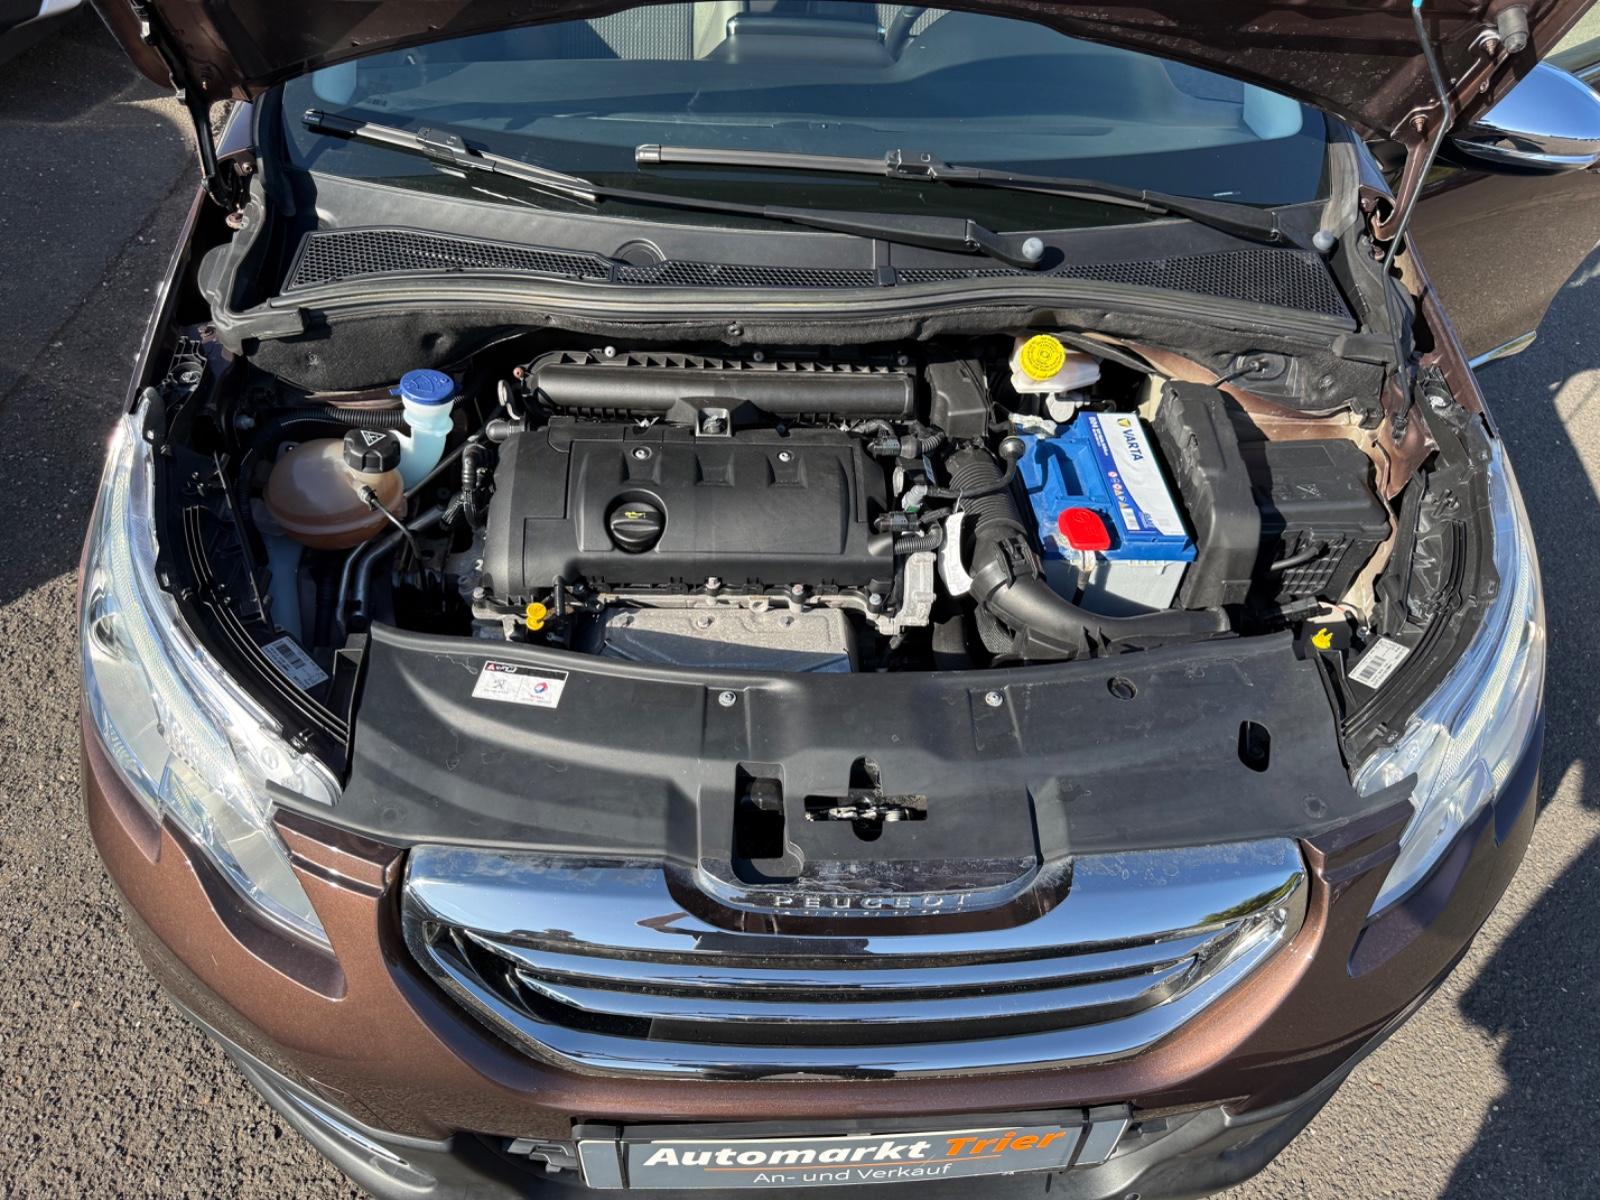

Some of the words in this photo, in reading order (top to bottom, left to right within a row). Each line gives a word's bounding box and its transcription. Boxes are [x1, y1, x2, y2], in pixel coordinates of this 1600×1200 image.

[1122, 428, 1144, 462] VARTA
[773, 893, 971, 909] PEUGEOT
[643, 1140, 931, 1166] Automarkt
[945, 1131, 1067, 1156] Trier
[753, 1172, 796, 1184] An-
[803, 1169, 850, 1182] und
[857, 1163, 952, 1180] Verkauf
